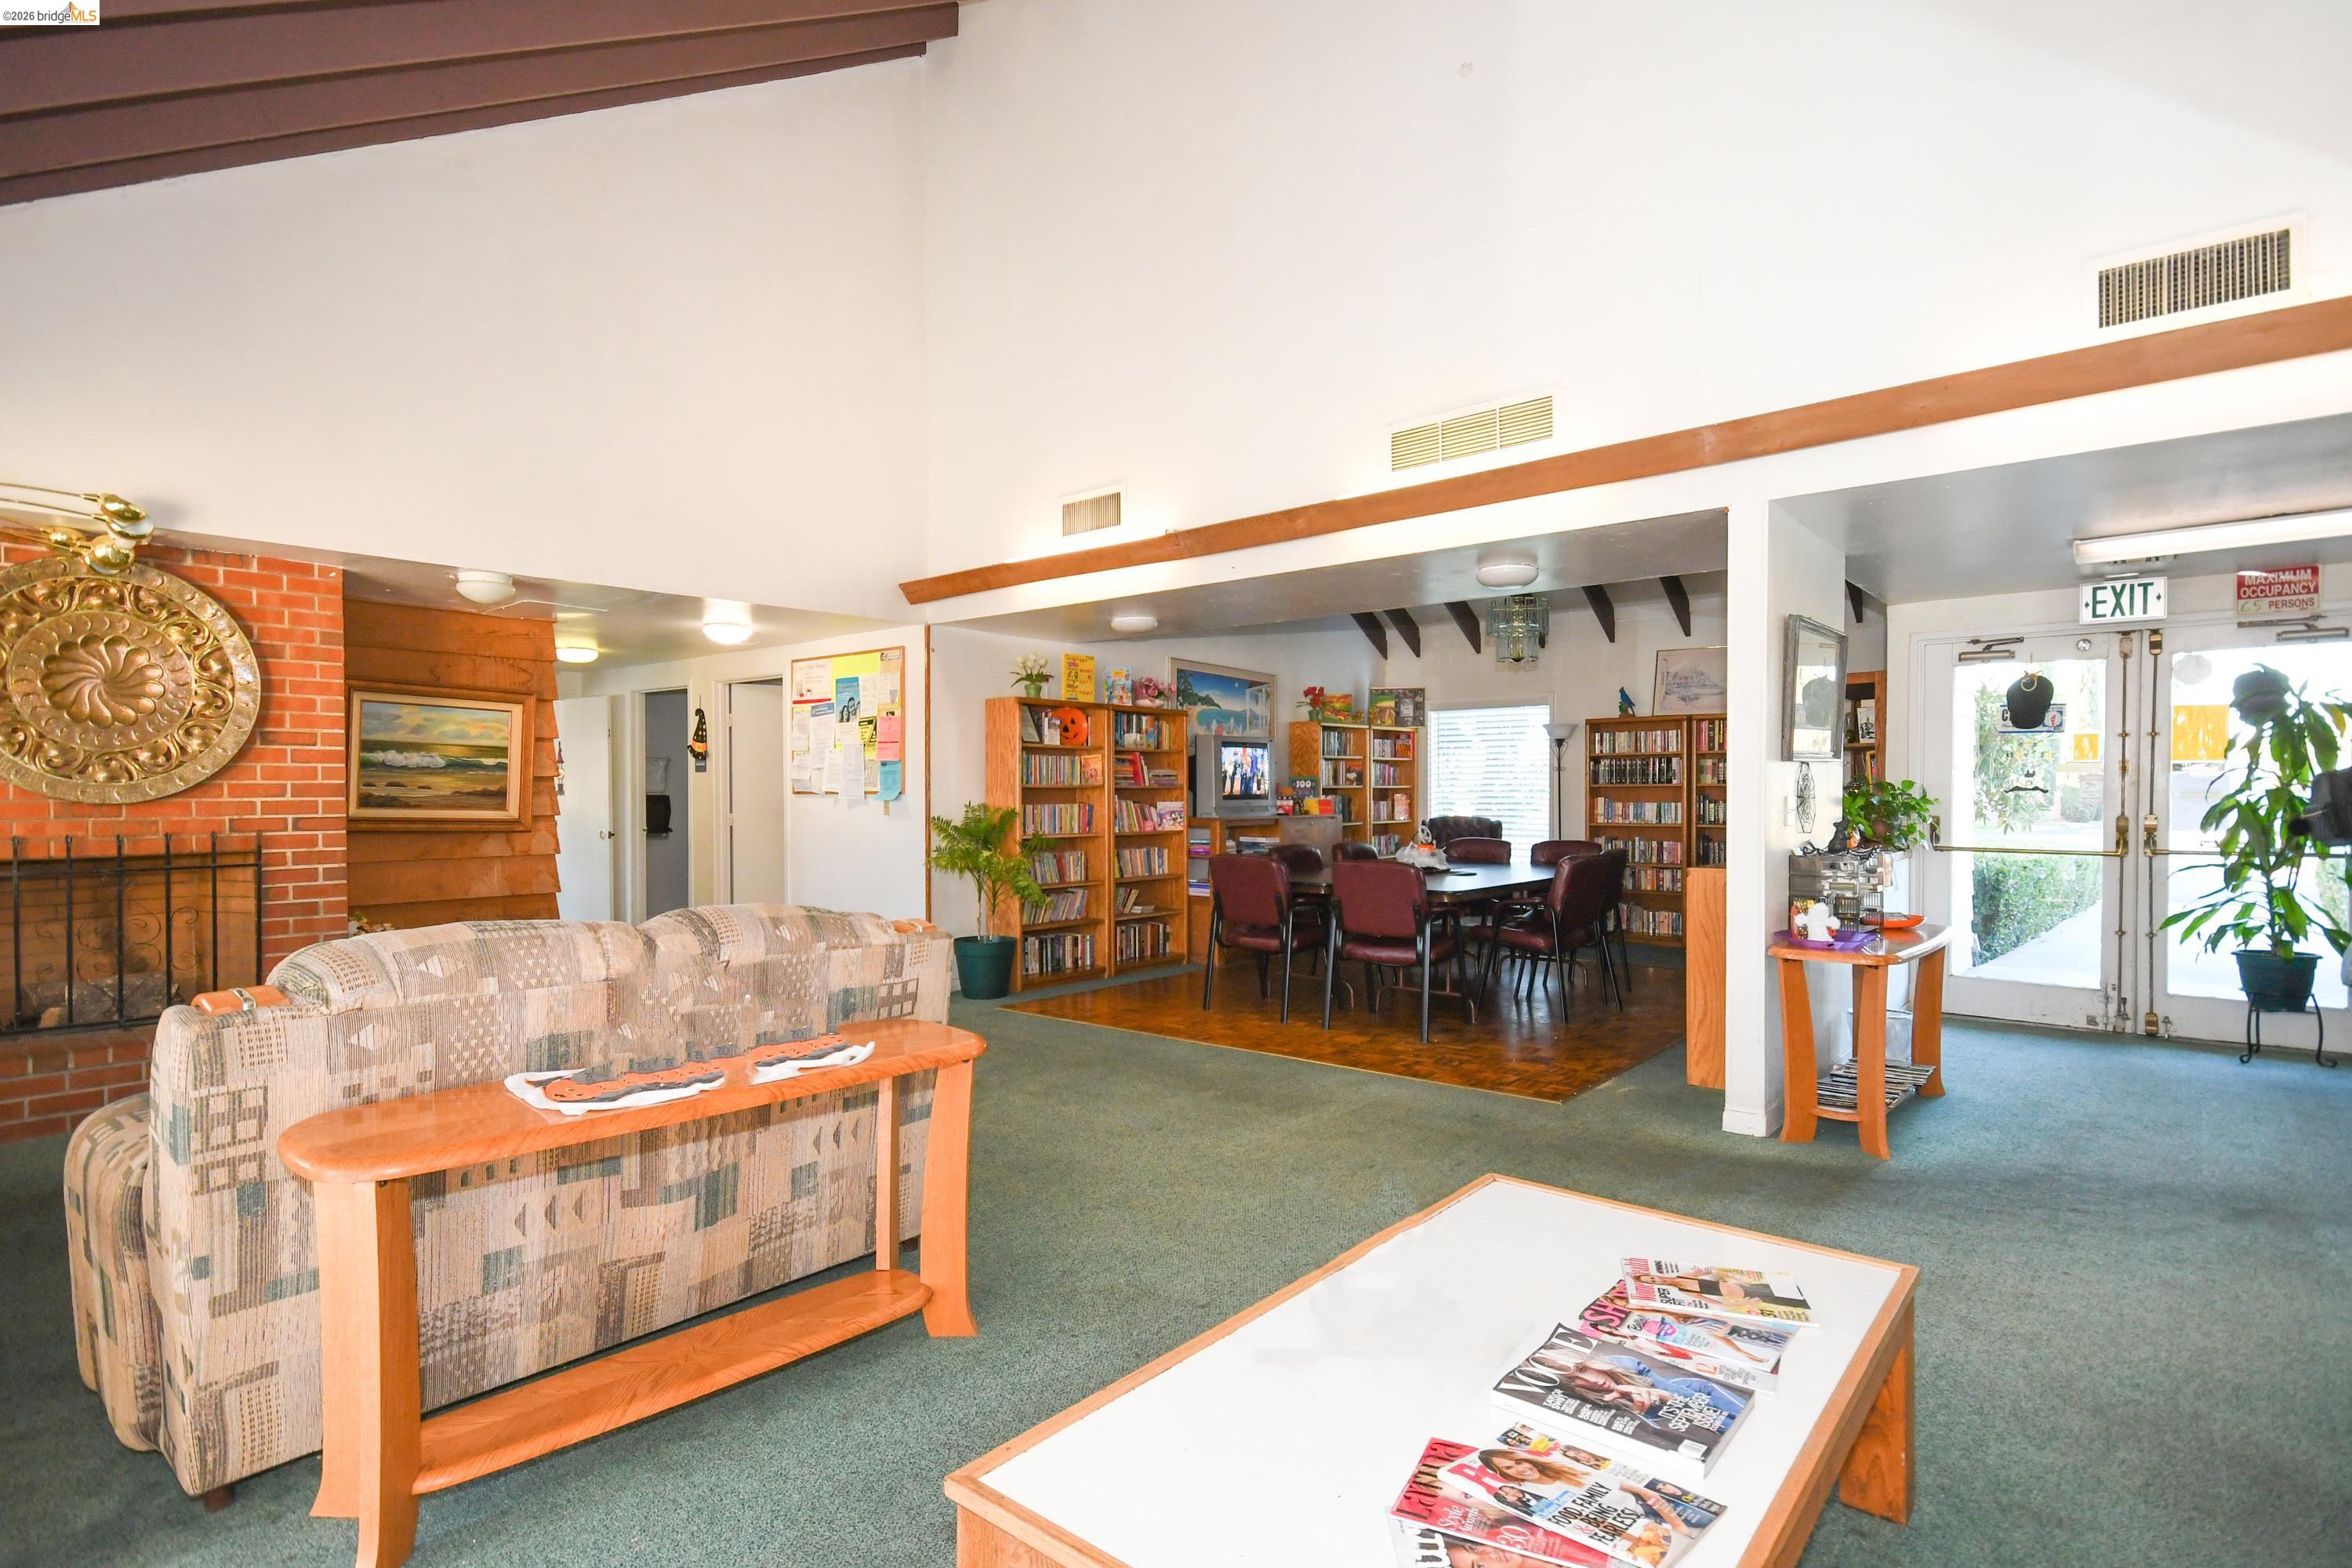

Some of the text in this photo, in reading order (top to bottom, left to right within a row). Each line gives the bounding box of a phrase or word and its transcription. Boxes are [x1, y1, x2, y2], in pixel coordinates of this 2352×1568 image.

[2245, 568, 2312, 586] MAXIMUM
[2092, 582, 2154, 619] EXIT
[2240, 582, 2317, 597] OCCUPANCY
[2269, 597, 2315, 609] PERSONS
[1630, 1279, 1657, 1301] Wome
[1657, 1287, 1671, 1304] SUPER
[1667, 1393, 1690, 1408] THE
[1668, 1392, 1711, 1432] SEPTEMBER
[1692, 1406, 1721, 1428] ISSUE!
[1547, 1506, 1586, 1528] FOOD,
[1571, 1482, 1612, 1509] FAMILY
[1580, 1503, 1618, 1528] BEING
[1437, 1505, 1465, 1528] Style
[1588, 1507, 1645, 1545] FEARLESS!
[1497, 1526, 1530, 1551] 30
